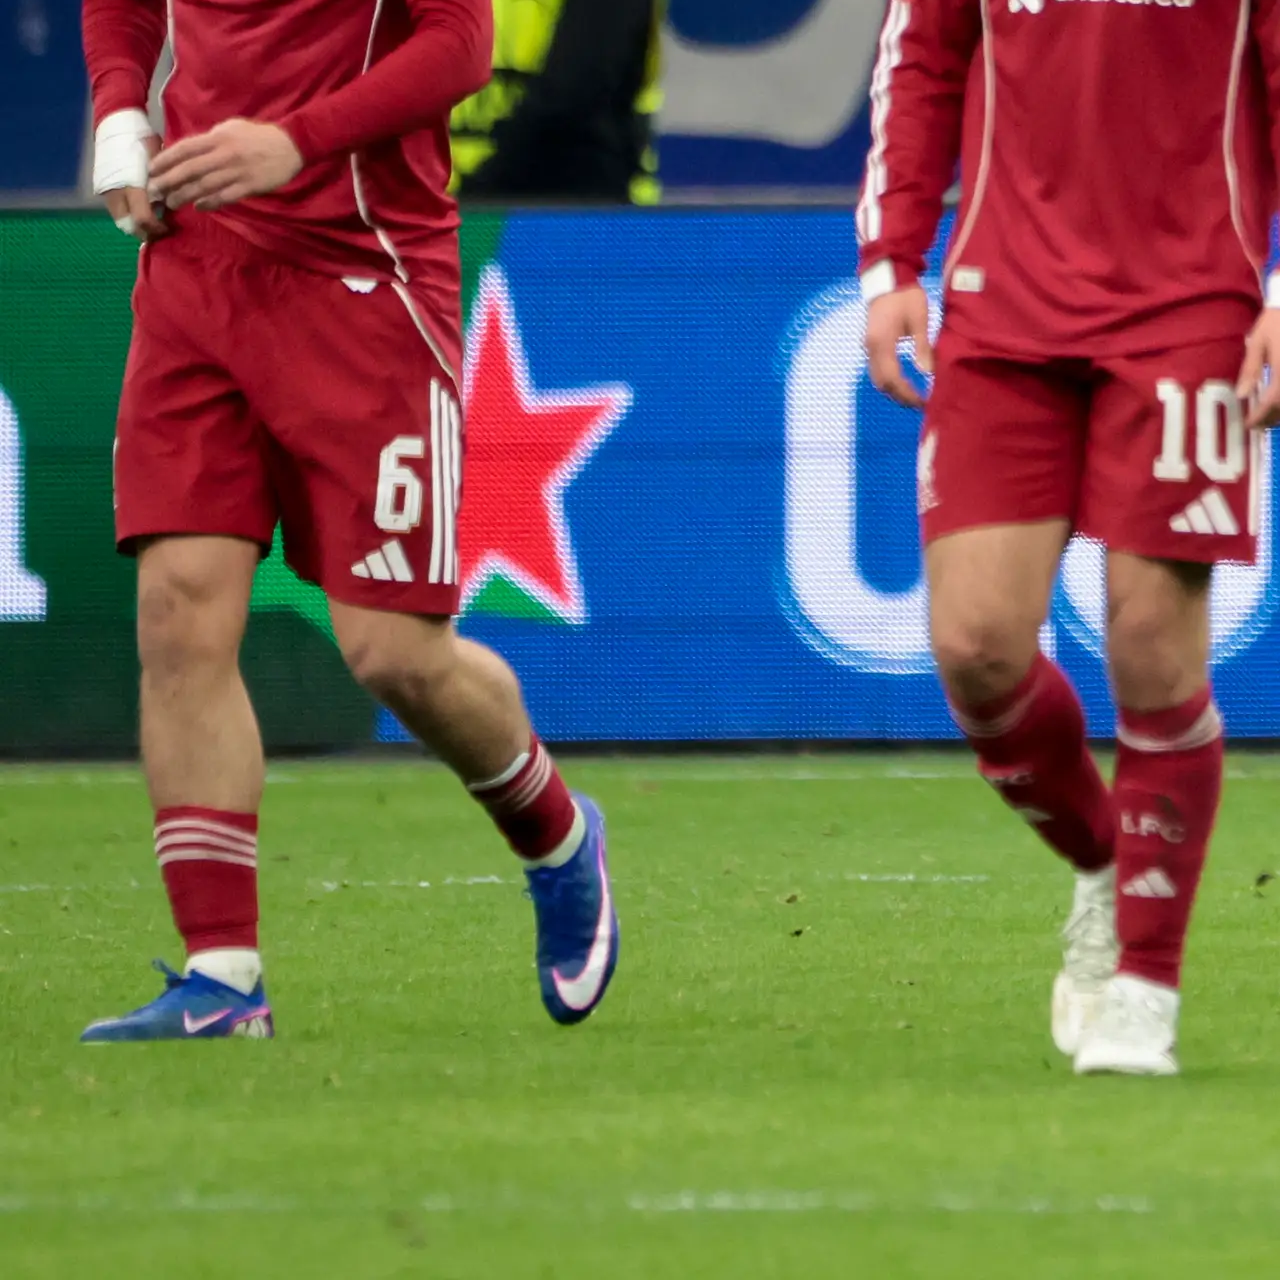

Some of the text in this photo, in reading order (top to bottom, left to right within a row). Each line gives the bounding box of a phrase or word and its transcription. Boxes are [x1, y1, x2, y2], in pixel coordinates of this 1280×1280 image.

[1153, 378, 1249, 483] 10
[373, 435, 424, 533] 6
[1121, 811, 1185, 845] LFC
